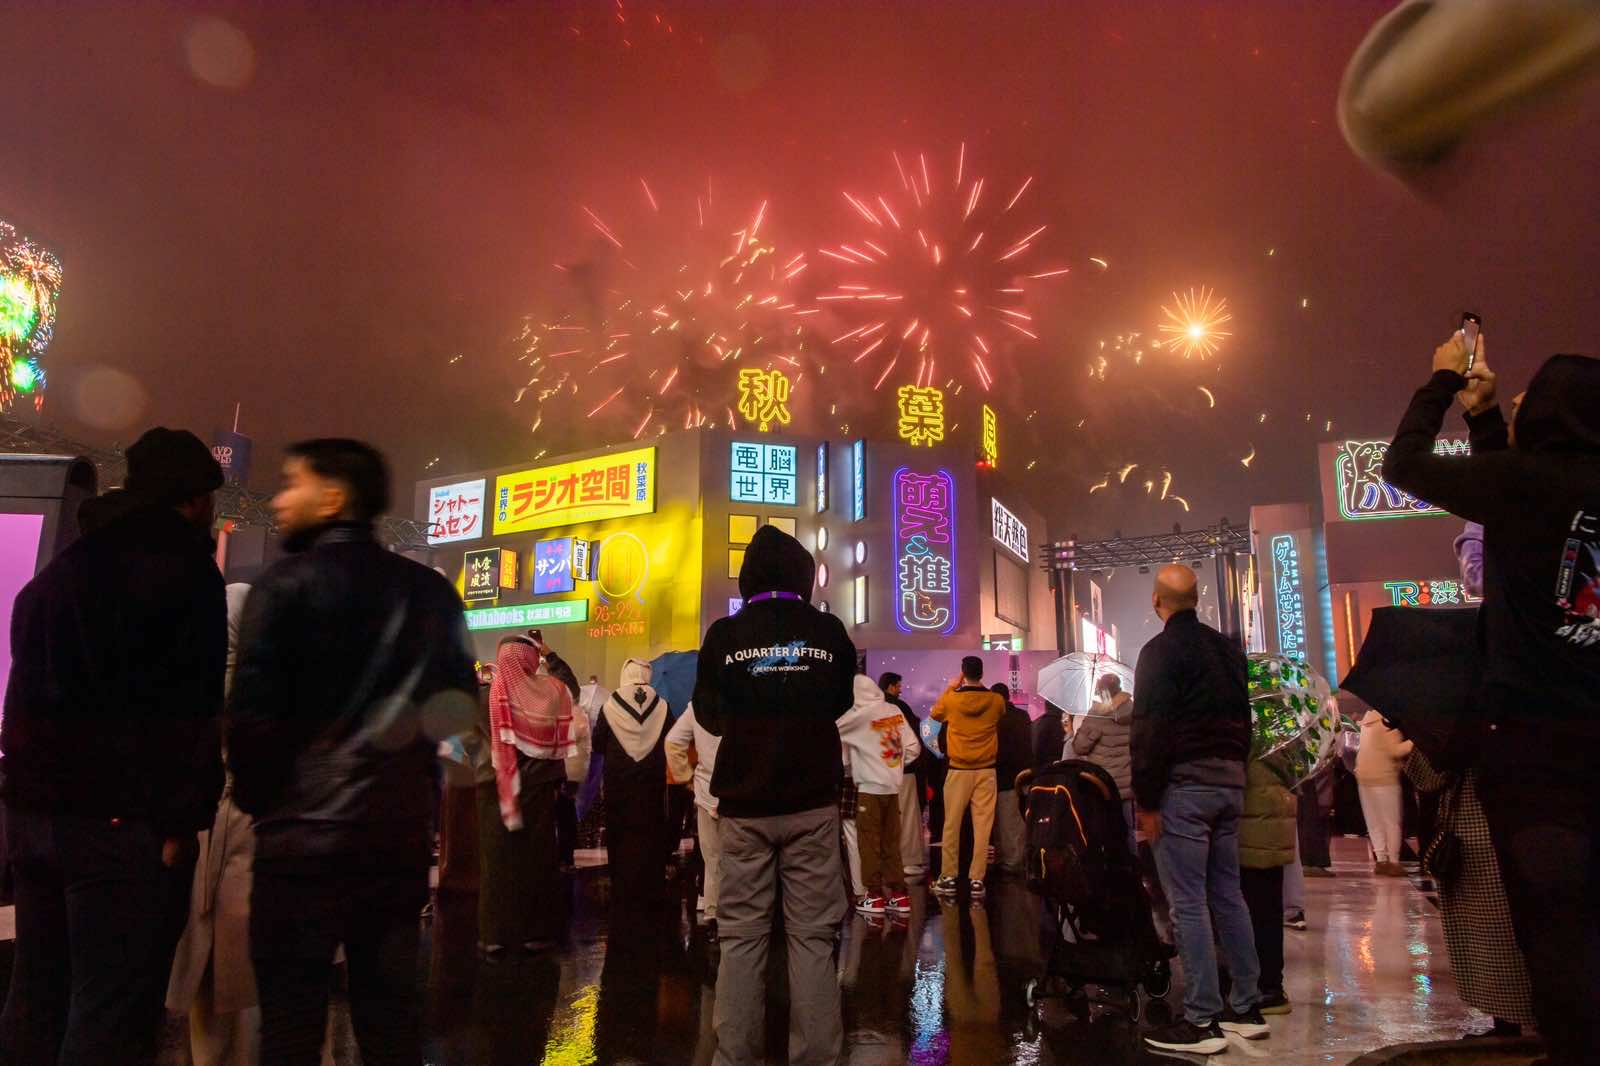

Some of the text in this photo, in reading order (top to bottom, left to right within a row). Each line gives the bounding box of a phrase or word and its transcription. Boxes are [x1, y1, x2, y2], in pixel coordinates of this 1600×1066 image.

[512, 463, 631, 516] ラジオ空間
[434, 494, 481, 514] シャトー
[725, 647, 833, 665] A QUARTER AFTER 3
